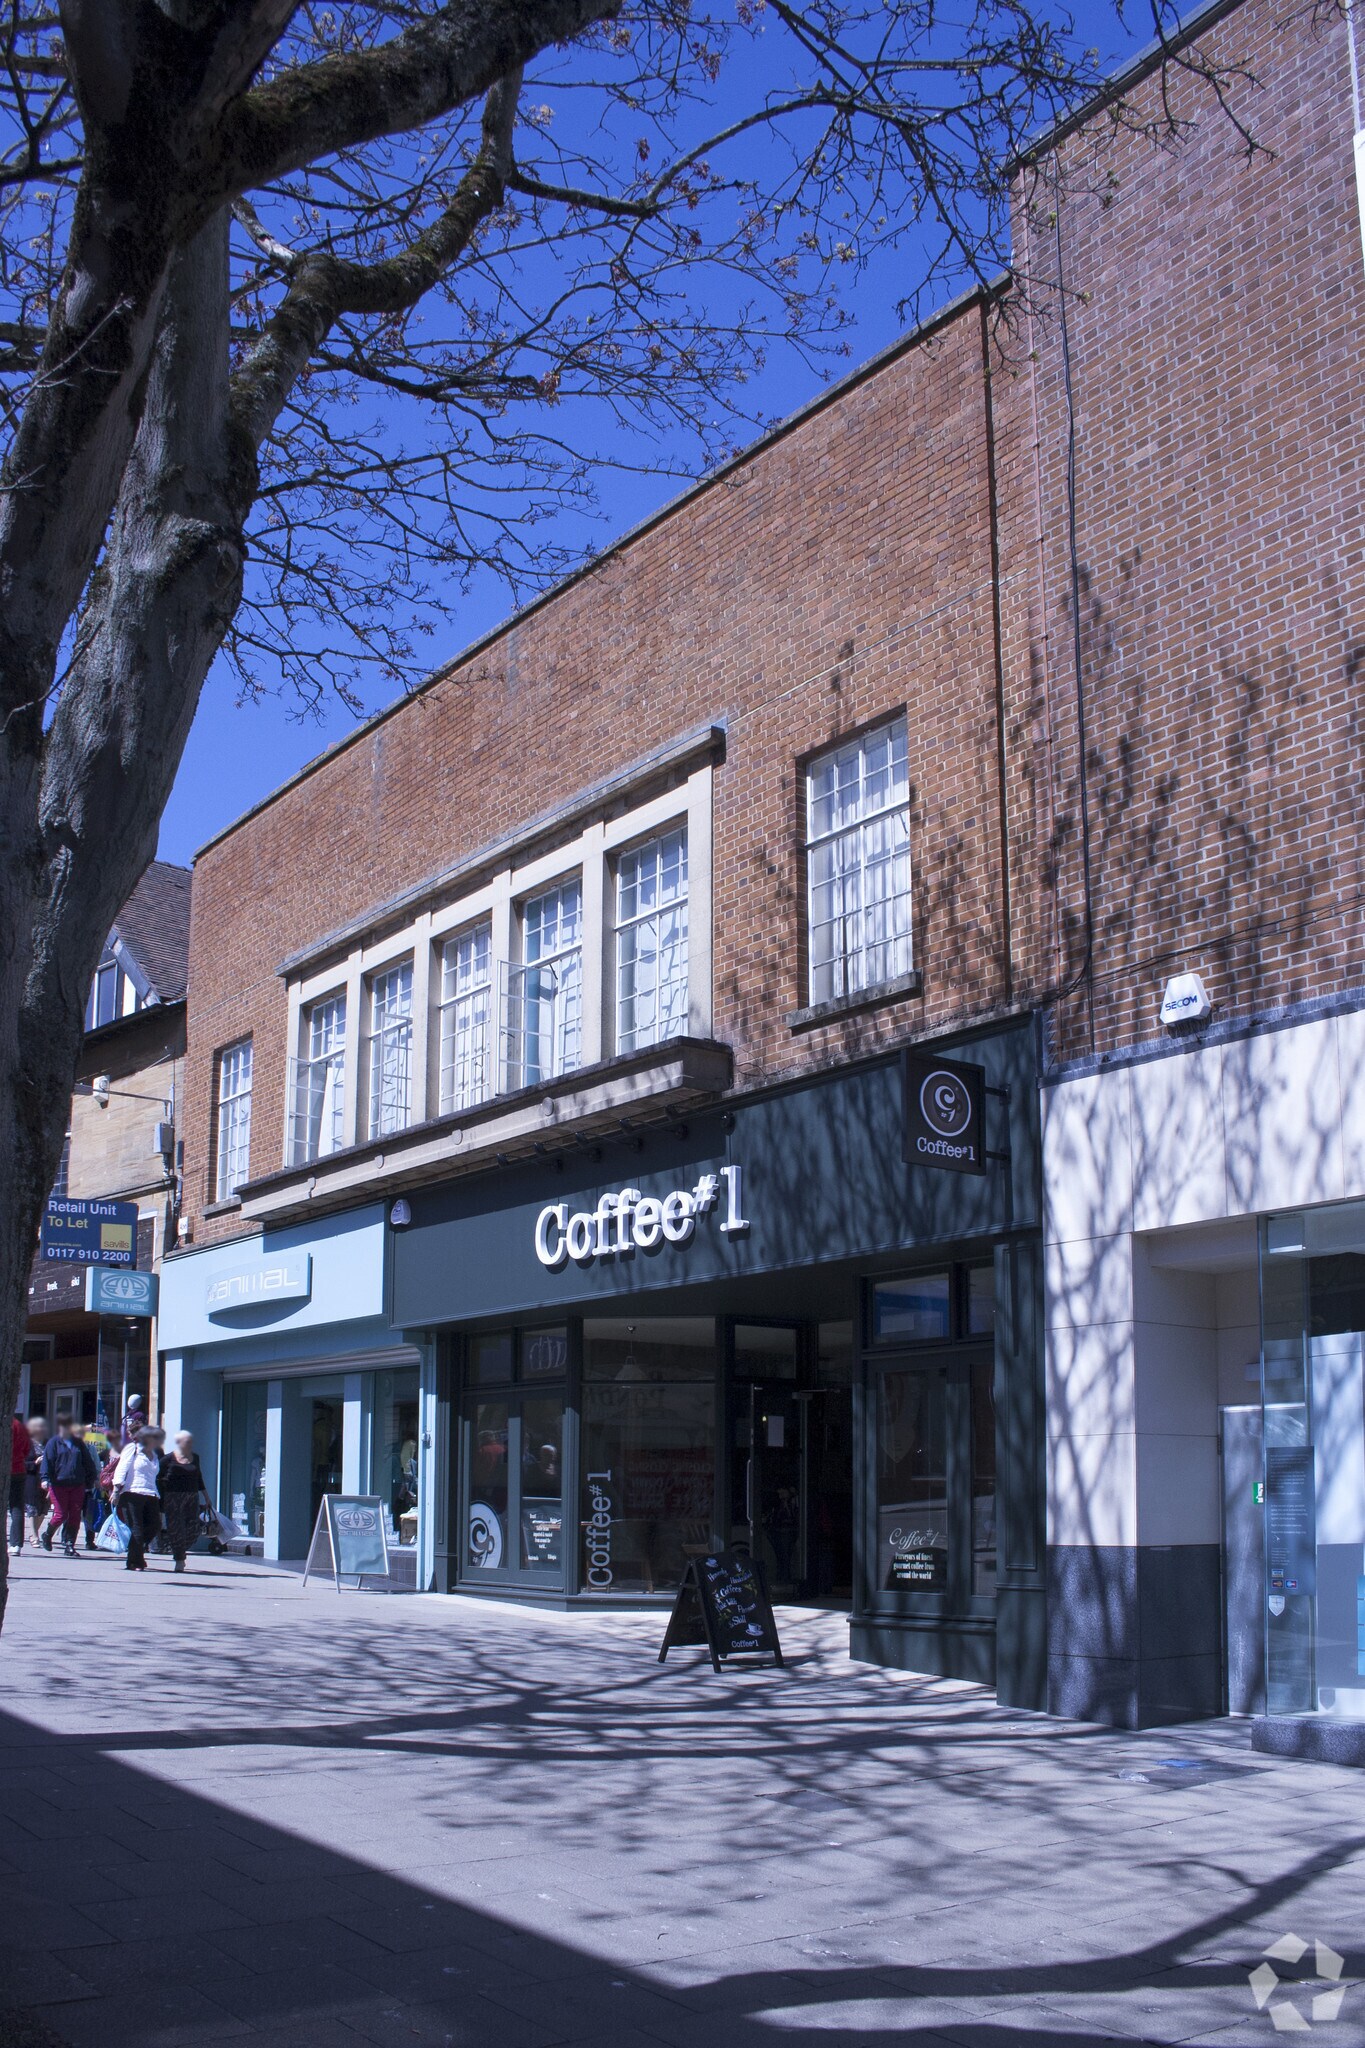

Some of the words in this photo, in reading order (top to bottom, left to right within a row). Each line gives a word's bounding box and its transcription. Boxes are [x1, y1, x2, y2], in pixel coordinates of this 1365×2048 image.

[1165, 995, 1197, 1011] SECOM
[917, 1137, 975, 1161] Coffee#1
[48, 1200, 85, 1214] Retail
[90, 1203, 117, 1216] Unit
[535, 1165, 750, 1265] Coffee#1
[47, 1215, 63, 1227] To
[67, 1216, 88, 1229] Let
[103, 1240, 130, 1249] savills
[47, 1248, 74, 1258] 0117
[78, 1249, 99, 1259] 910
[102, 1251, 130, 1261] 2200
[586, 1469, 613, 1586] Coffee#1
[889, 1527, 939, 1550] Coffee#1
